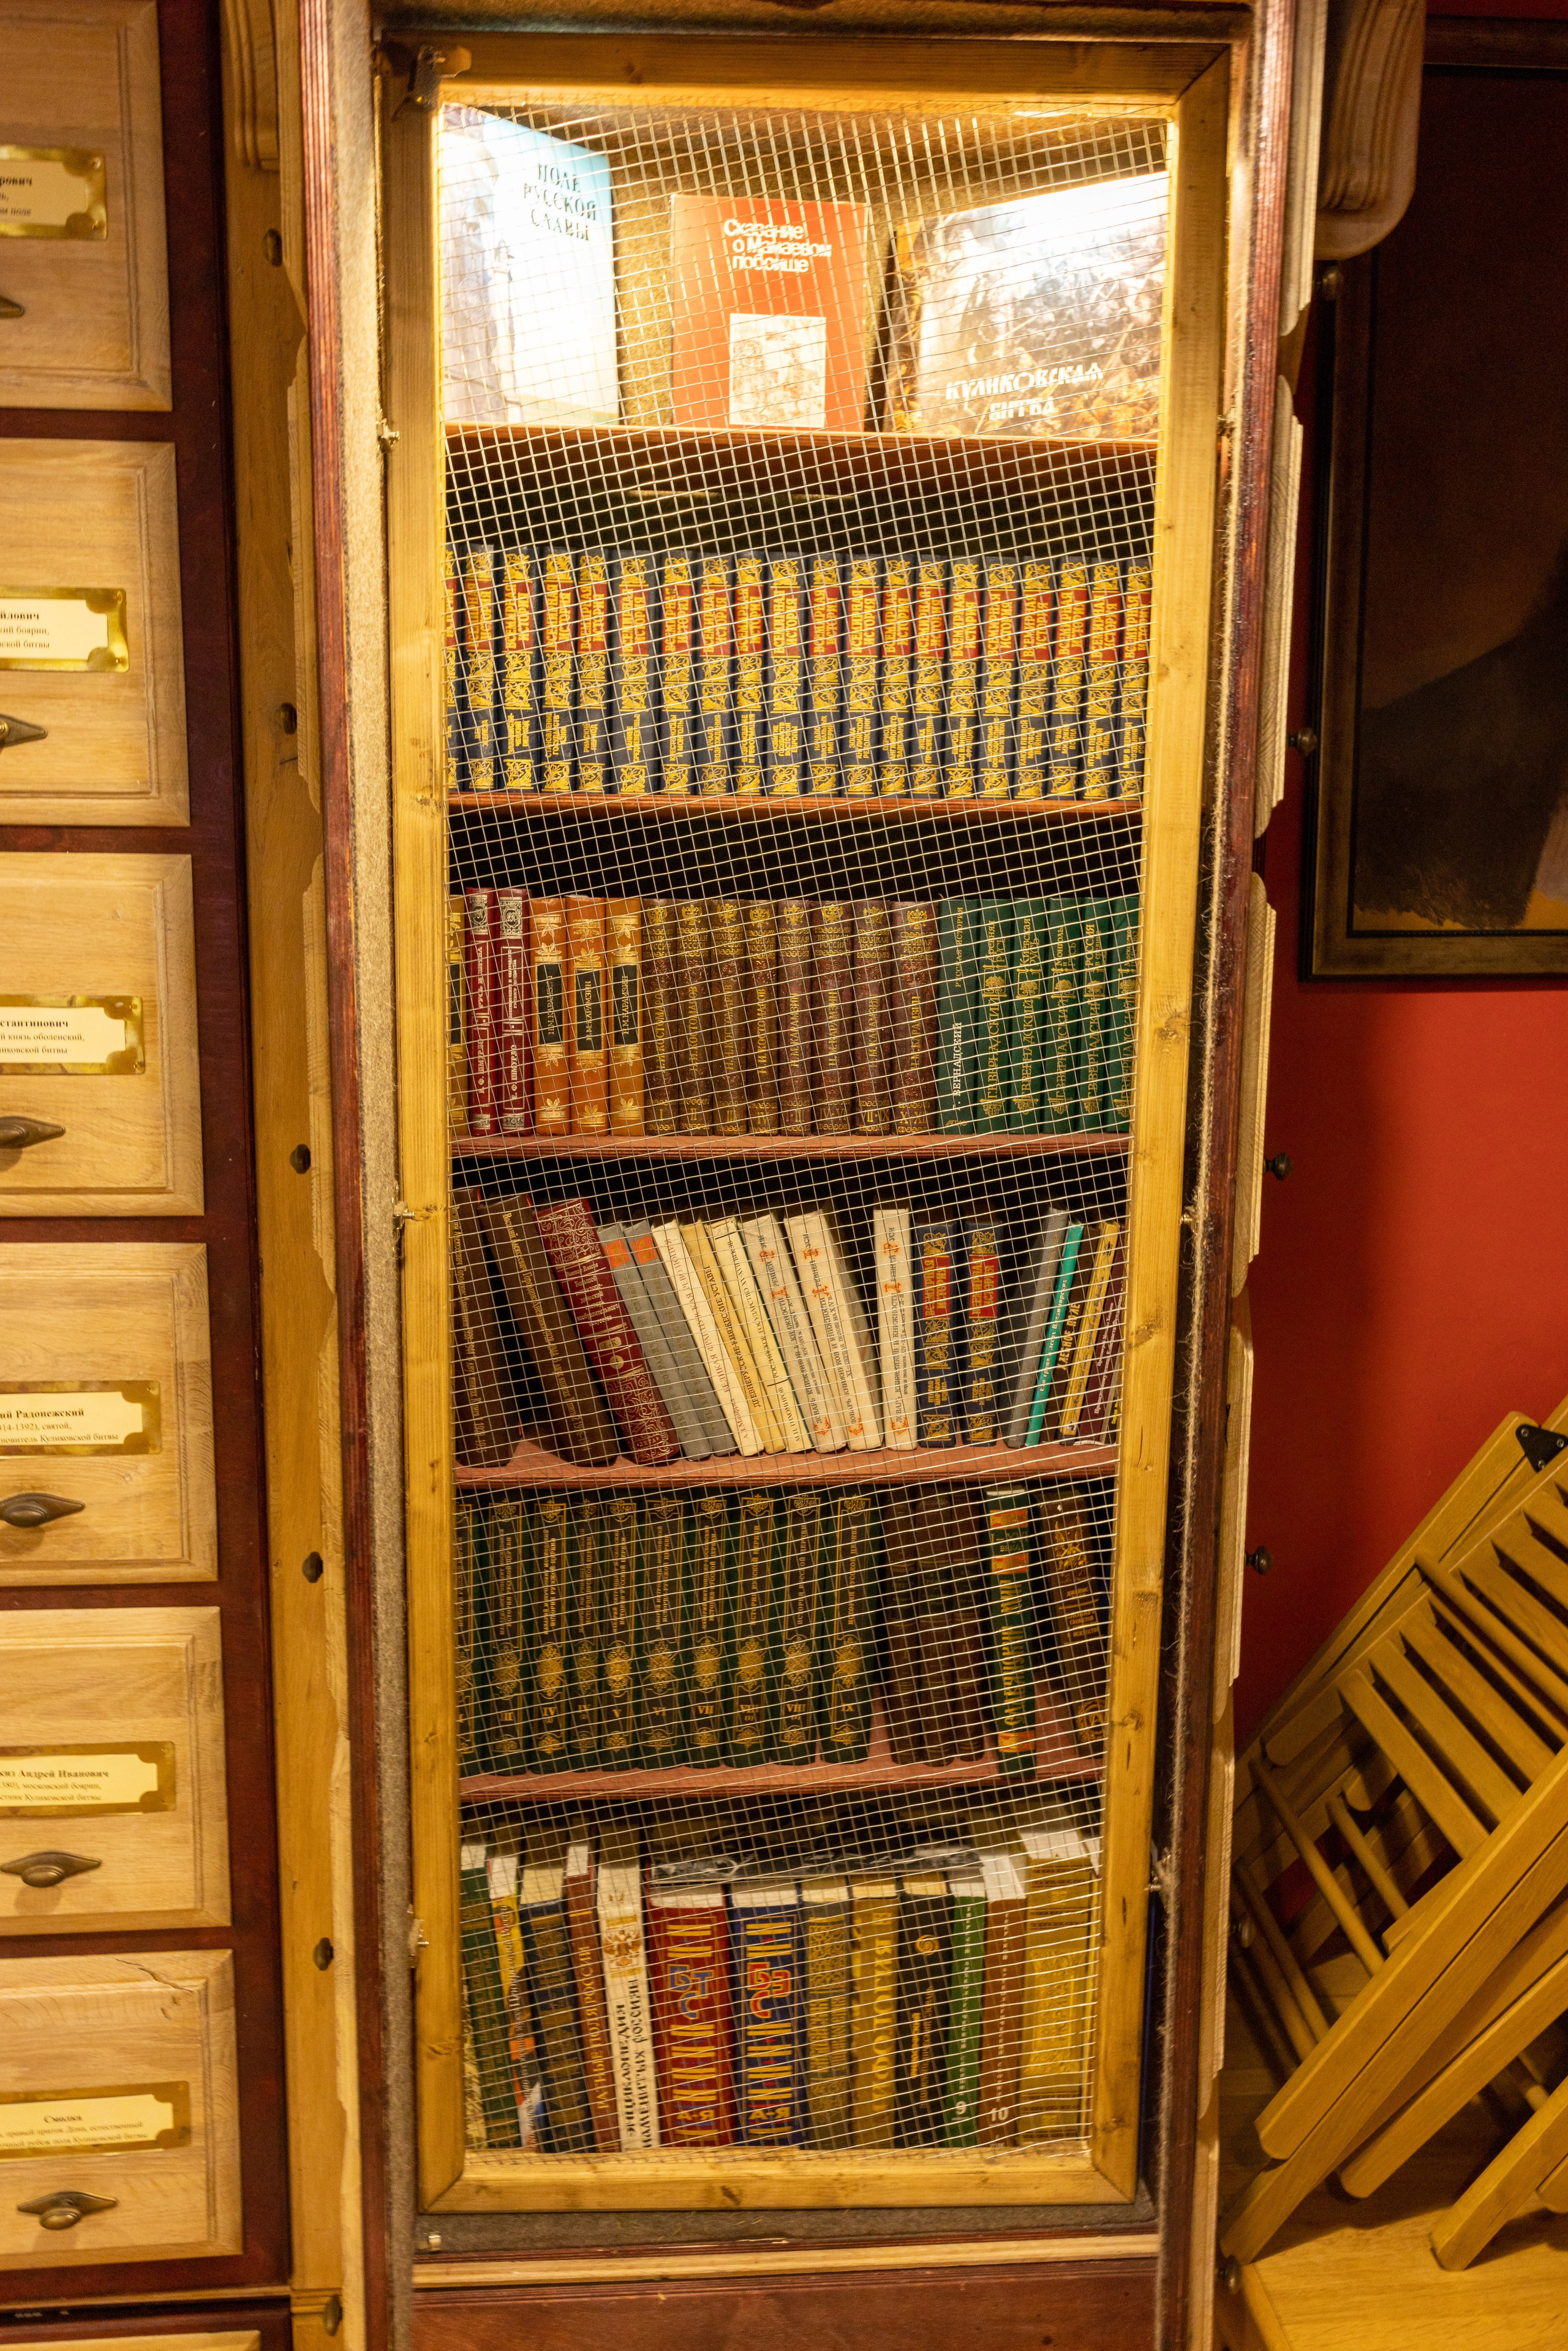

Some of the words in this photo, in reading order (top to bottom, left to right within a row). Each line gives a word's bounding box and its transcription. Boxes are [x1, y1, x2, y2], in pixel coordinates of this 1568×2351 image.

[538, 162, 580, 192] ПОЛЕ
[523, 183, 597, 221] РУССКОЙ
[530, 208, 590, 242] СЛАВЫ
[724, 219, 805, 240] Сказание
[733, 240, 745, 253] о
[746, 236, 832, 257] Мамаевом
[732, 258, 809, 273] побоище
[946, 362, 1104, 410] КУЛИКОВСКАЯ
[989, 396, 1058, 421] БИТВА
[17, 626, 50, 635] боярин,
[1020, 918, 1031, 966] Киевская
[1085, 924, 1095, 967] РОССИЯ
[34, 1032, 85, 1041] оболенский,
[952, 1022, 962, 1096] ВЕРНАДСКИЙ
[704, 1266, 721, 1297] УСТАВЫ
[17, 1408, 85, 1419] Радонежский
[40, 1433, 91, 1444] Куликовской
[18, 1770, 55, 1779] Андрей
[23, 1781, 69, 1790] московский
[70, 1782, 102, 1791] боярин,
[24, 1793, 74, 1802] Куликовской
[579, 1944, 597, 2006] РОССИИ
[749, 2107, 791, 2121] А-Я
[955, 2100, 968, 2115] 9
[990, 2106, 1009, 2122] 10
